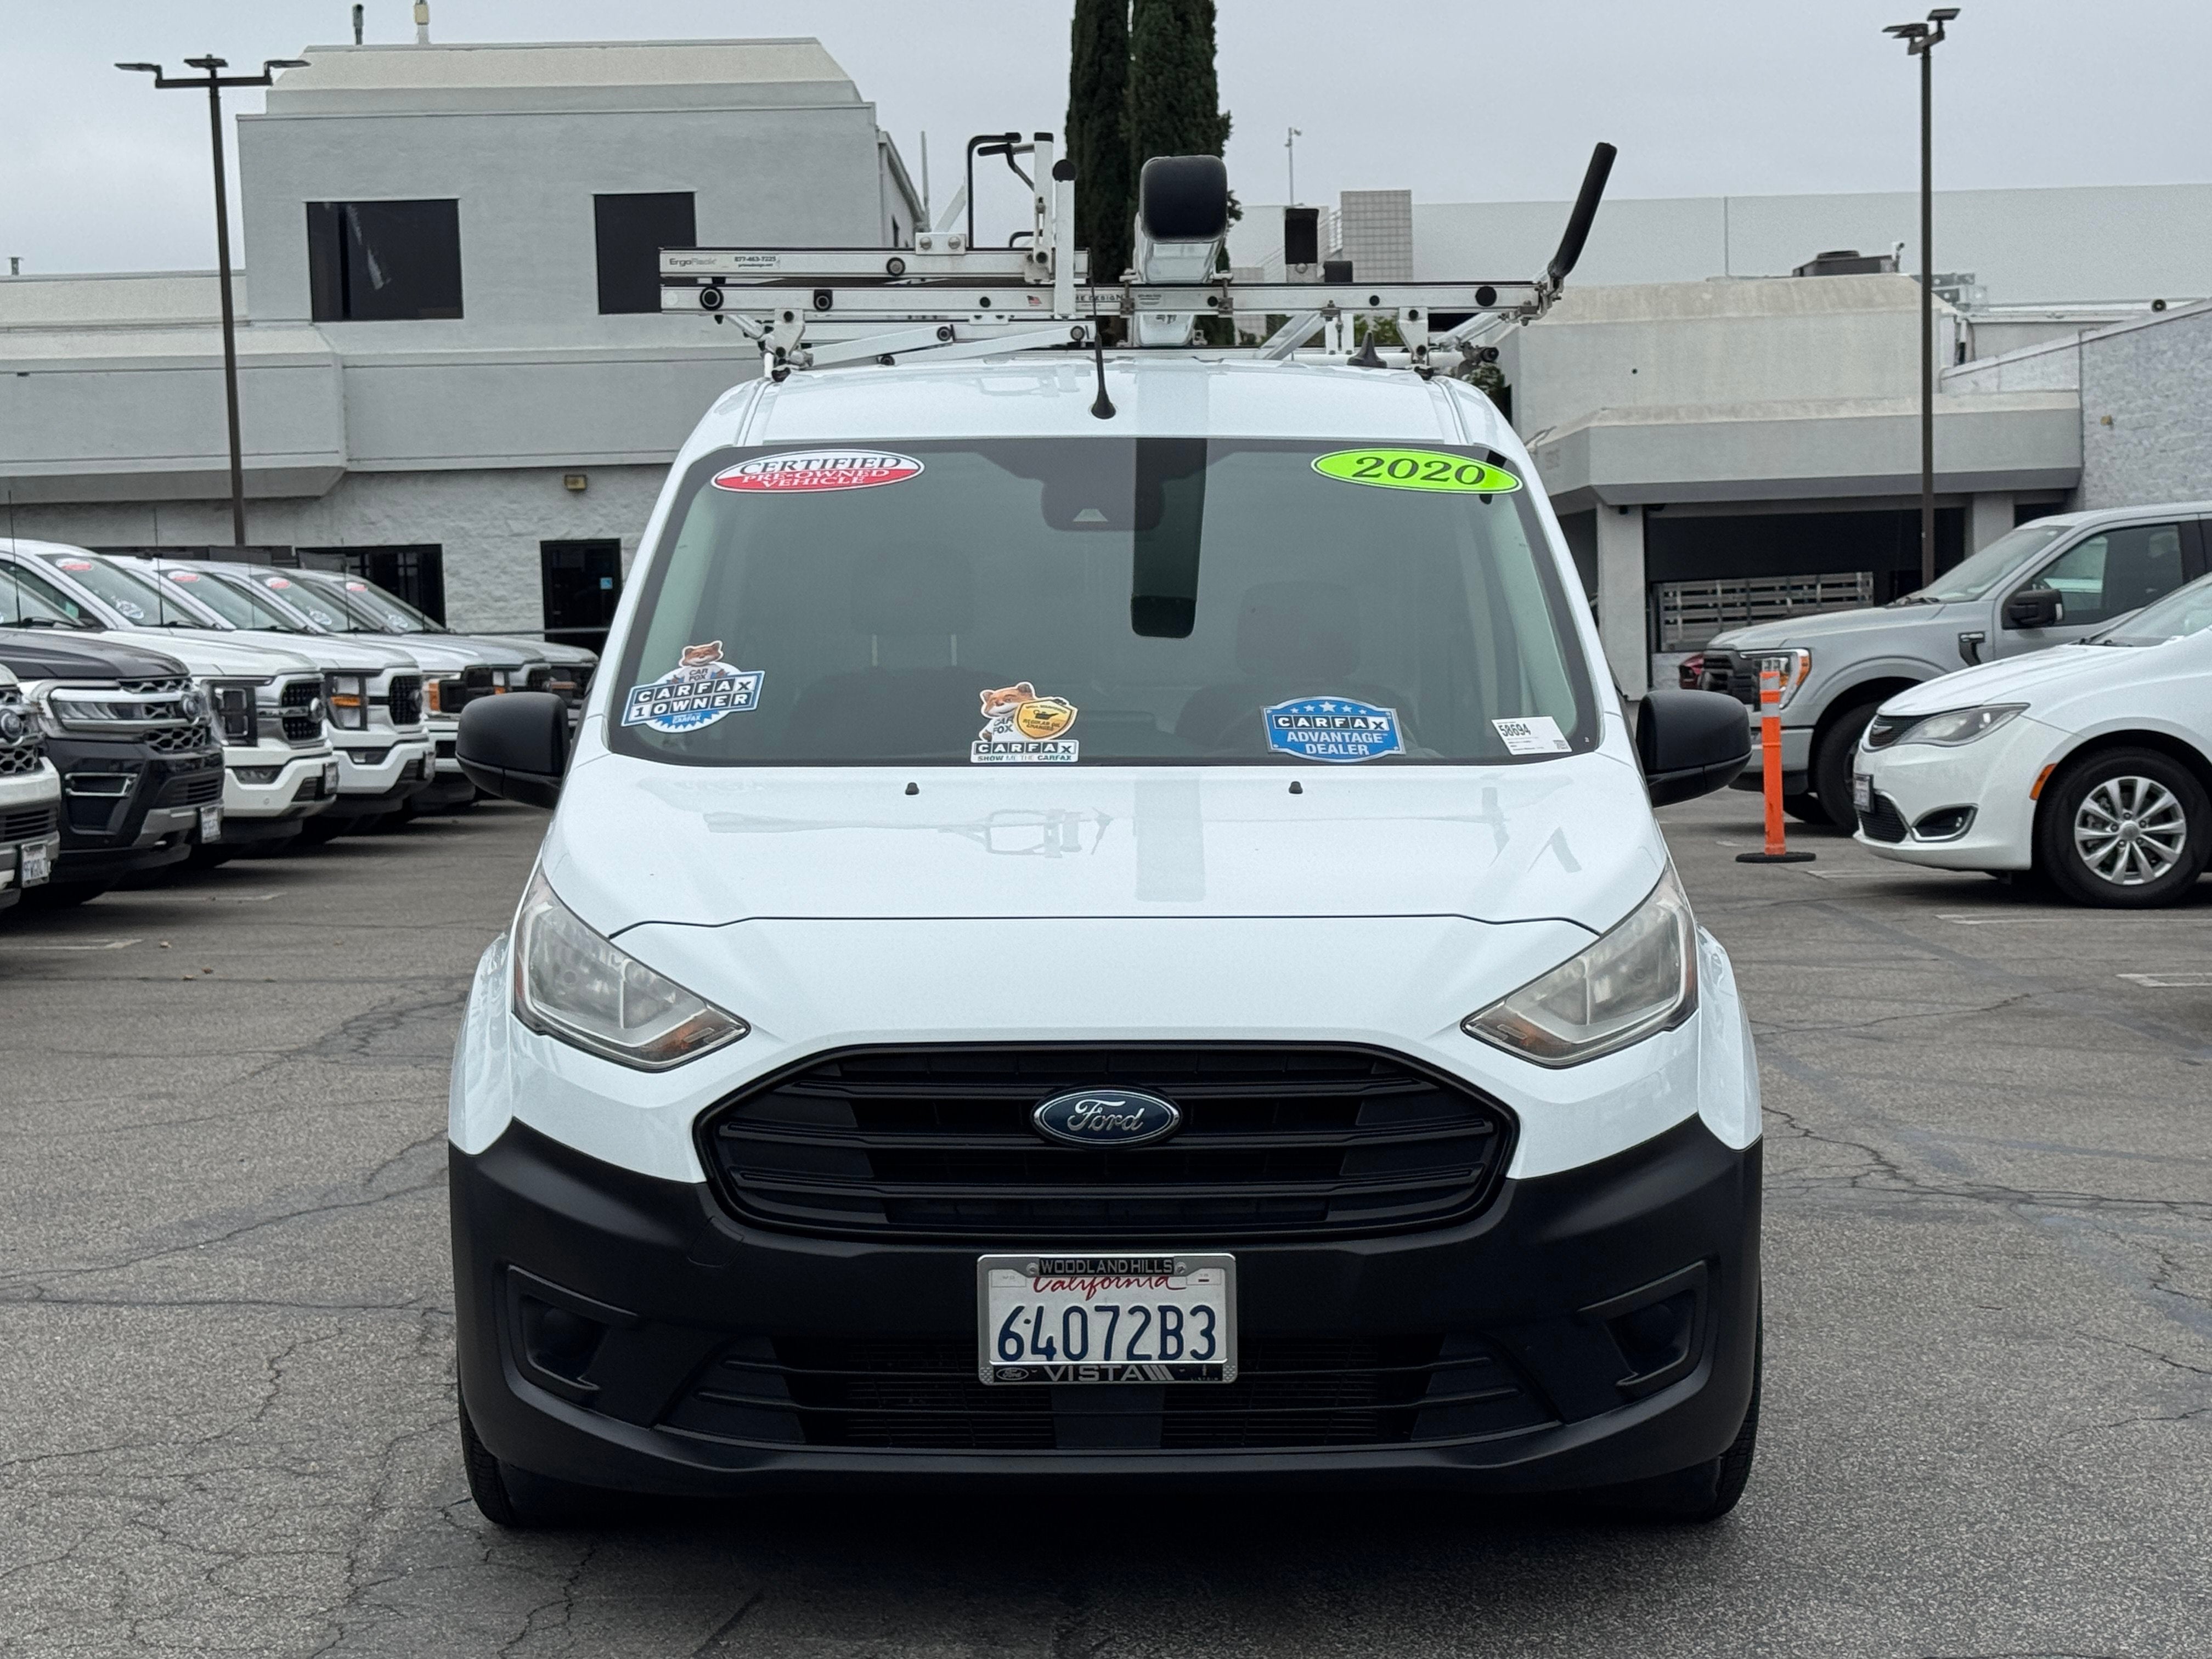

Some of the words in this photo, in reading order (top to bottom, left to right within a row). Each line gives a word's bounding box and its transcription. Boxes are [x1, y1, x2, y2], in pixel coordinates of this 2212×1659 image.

[740, 457, 901, 475] CERTIFIED
[1351, 456, 1485, 485] 2020
[742, 469, 890, 484] PRE-OWNED
[762, 476, 865, 488] VEHICLE
[638, 679, 752, 702] CARFAX
[994, 718, 1013, 726] CAR
[1278, 716, 1385, 730] CARFAX
[1498, 723, 1531, 736] 58694
[993, 725, 1013, 735] FOX
[1287, 731, 1384, 743] ADVANTAGE
[978, 743, 1071, 754] CARFAX
[1305, 743, 1369, 755] DEALER
[1067, 1099, 1145, 1131] Ford
[1042, 1259, 1130, 1274] WOODLAND
[1133, 1259, 1173, 1273] HILLS
[1033, 1276, 1187, 1301] California
[998, 1305, 1216, 1362] 64072B3
[1042, 1365, 1150, 1381] VISTA
